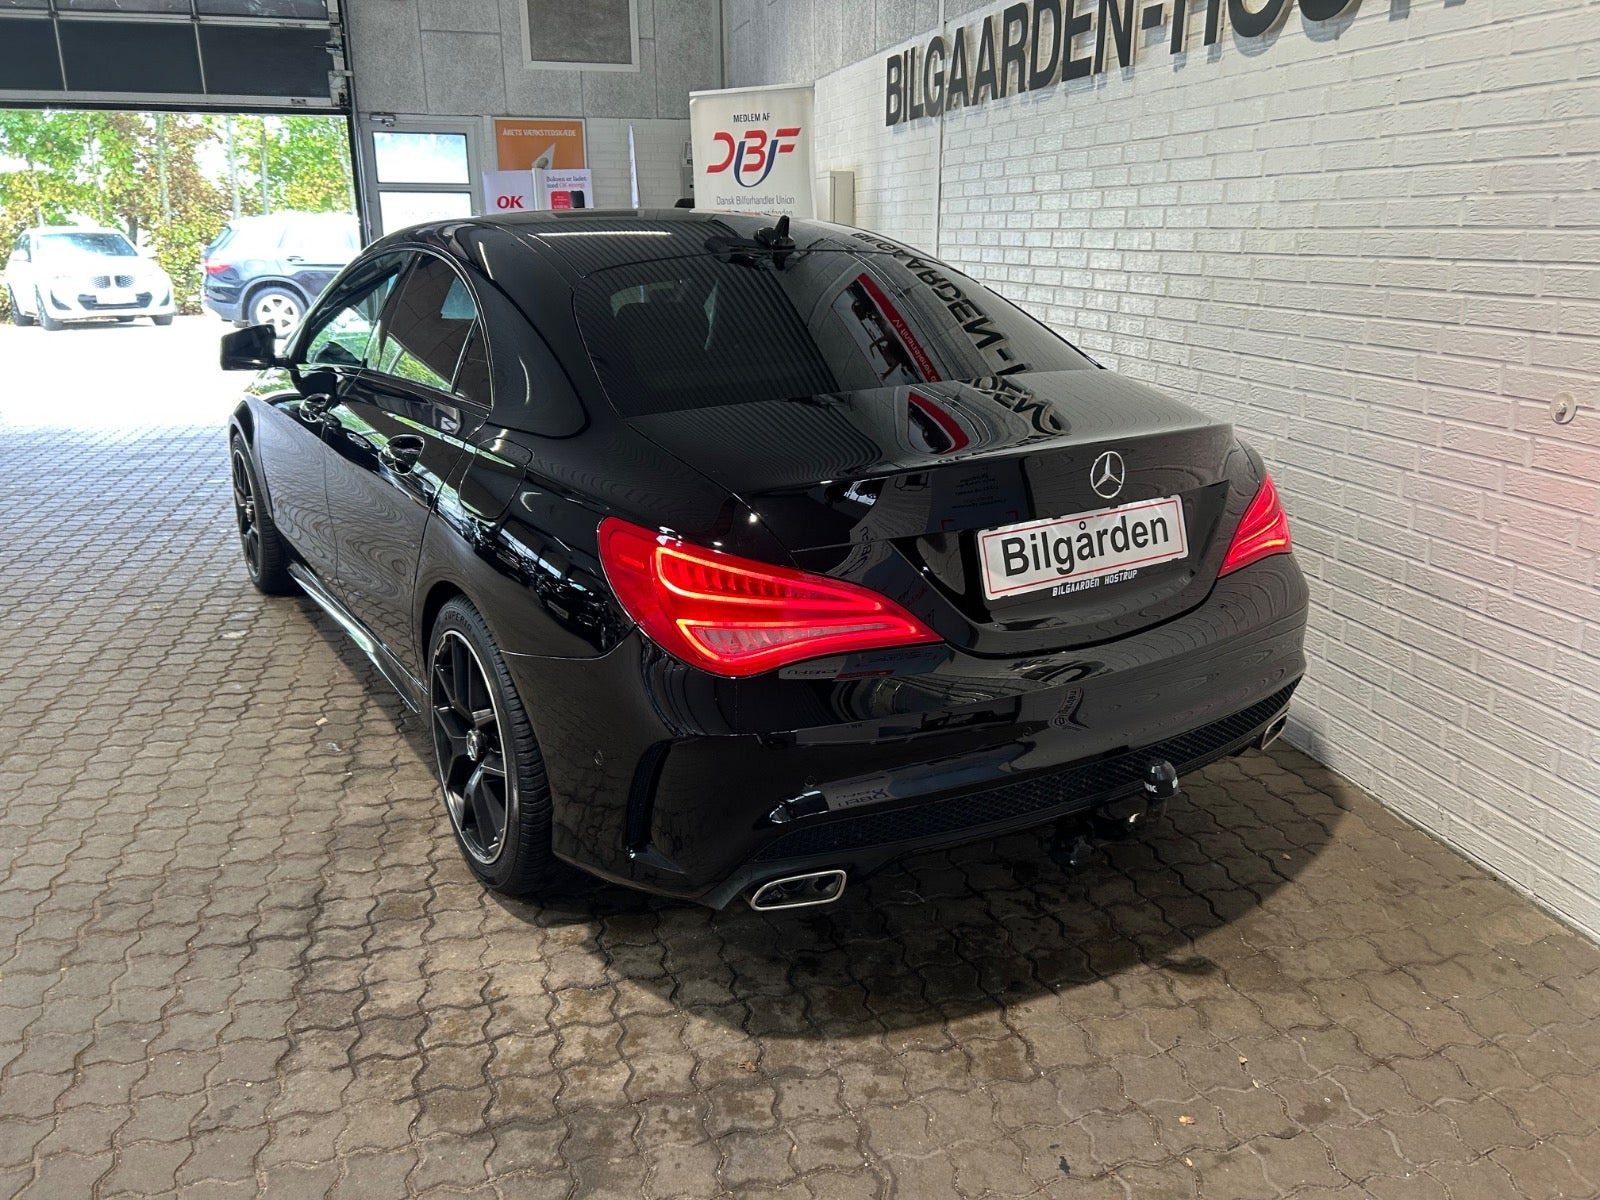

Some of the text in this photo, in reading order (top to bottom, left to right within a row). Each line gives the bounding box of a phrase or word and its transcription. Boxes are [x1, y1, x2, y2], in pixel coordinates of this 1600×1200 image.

[886, 0, 1354, 126] BILGAARDEN-
[733, 112, 771, 123] MEDLEM AF
[496, 195, 524, 209] OK
[716, 194, 795, 205] Dansk Bilforhandler Union
[1001, 515, 1169, 577] Bilgården
[1052, 570, 1138, 597] BILGAARDEN HOSTRUP
